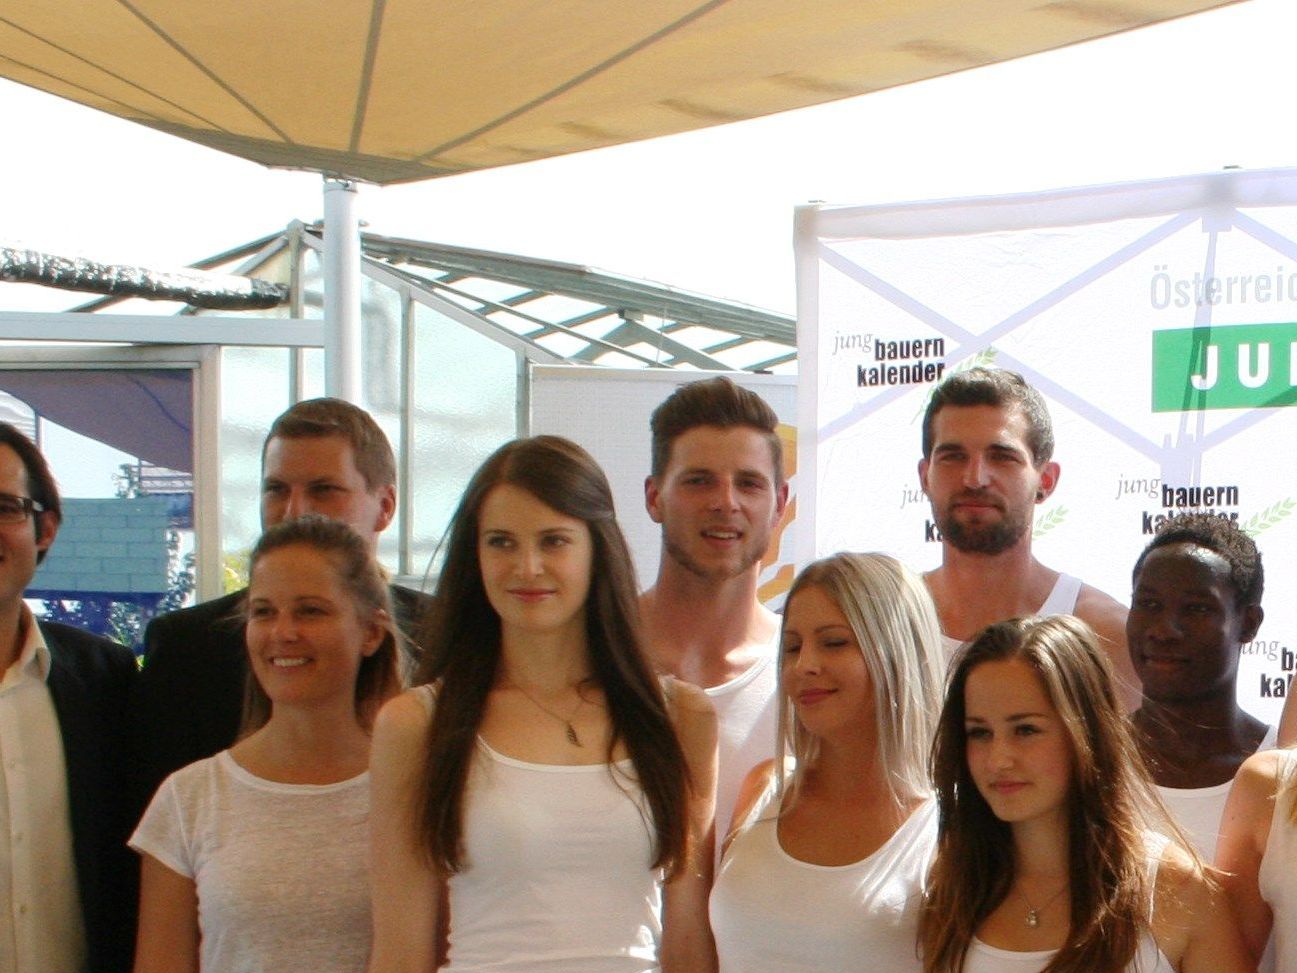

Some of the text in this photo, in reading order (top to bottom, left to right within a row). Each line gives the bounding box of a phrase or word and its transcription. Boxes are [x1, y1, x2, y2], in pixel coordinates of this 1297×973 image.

[832, 331, 944, 361] jung bauern
[857, 361, 945, 387] kalender
[1115, 474, 1239, 508] jung bauern
